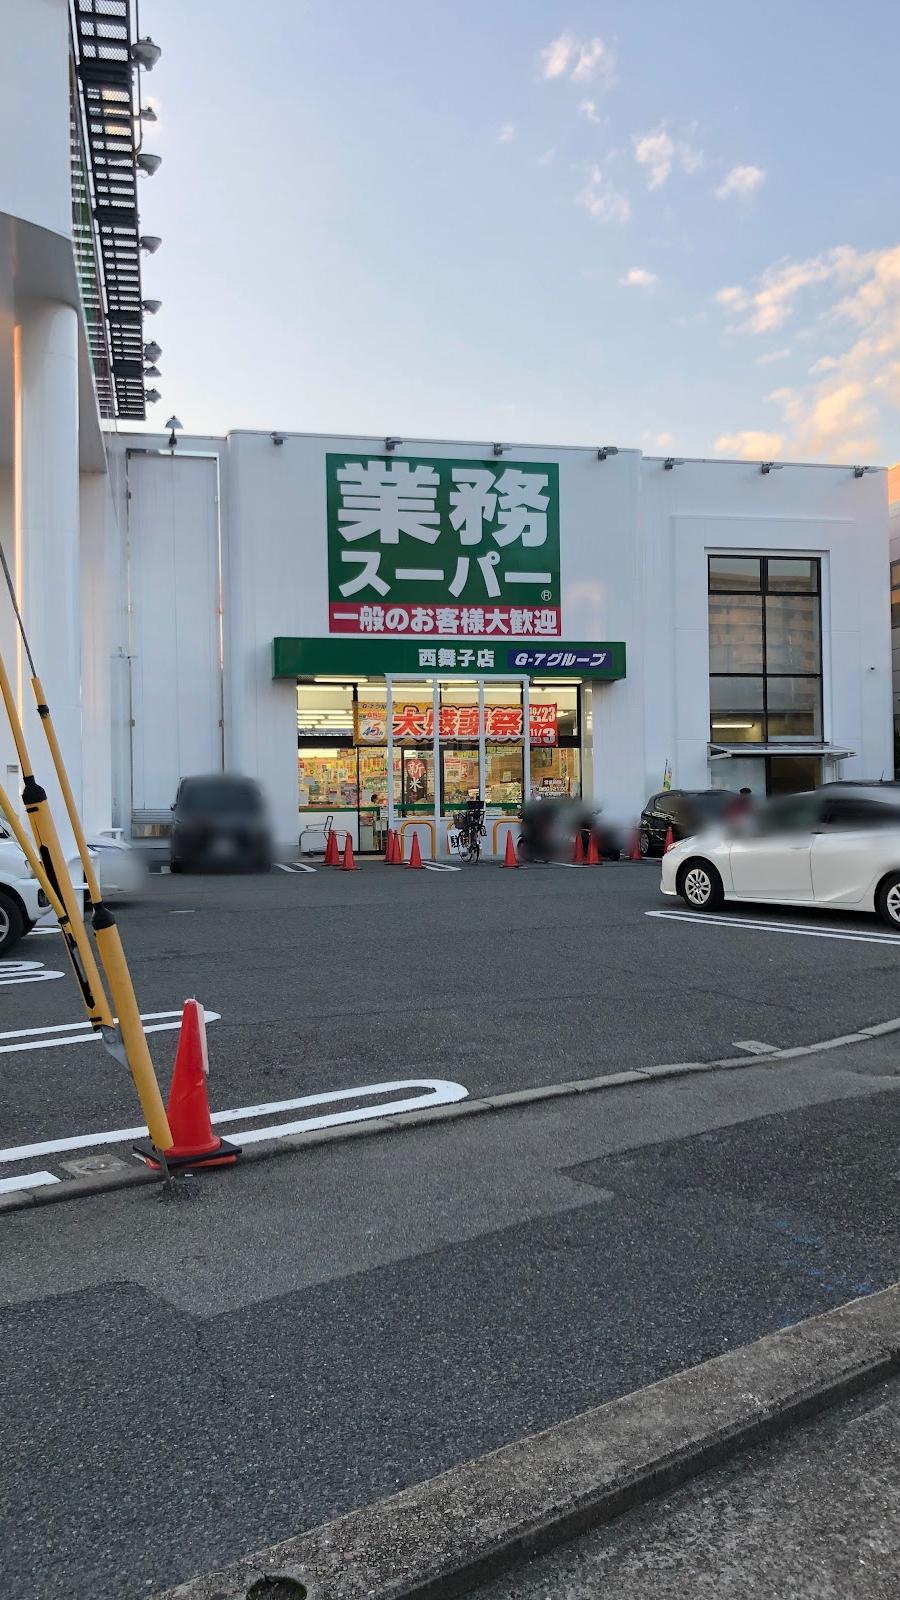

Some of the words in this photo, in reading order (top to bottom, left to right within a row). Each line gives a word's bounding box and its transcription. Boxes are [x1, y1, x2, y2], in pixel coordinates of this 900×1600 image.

[336, 460, 551, 547] 業務
[338, 550, 552, 598] スーパー
[333, 606, 558, 635] 一般のお客様大歓迎
[418, 648, 495, 668] 西舞子店
[515, 652, 607, 667] G-7グループ
[391, 706, 524, 737] 大感謝祭
[530, 728, 556, 743] 11/3
